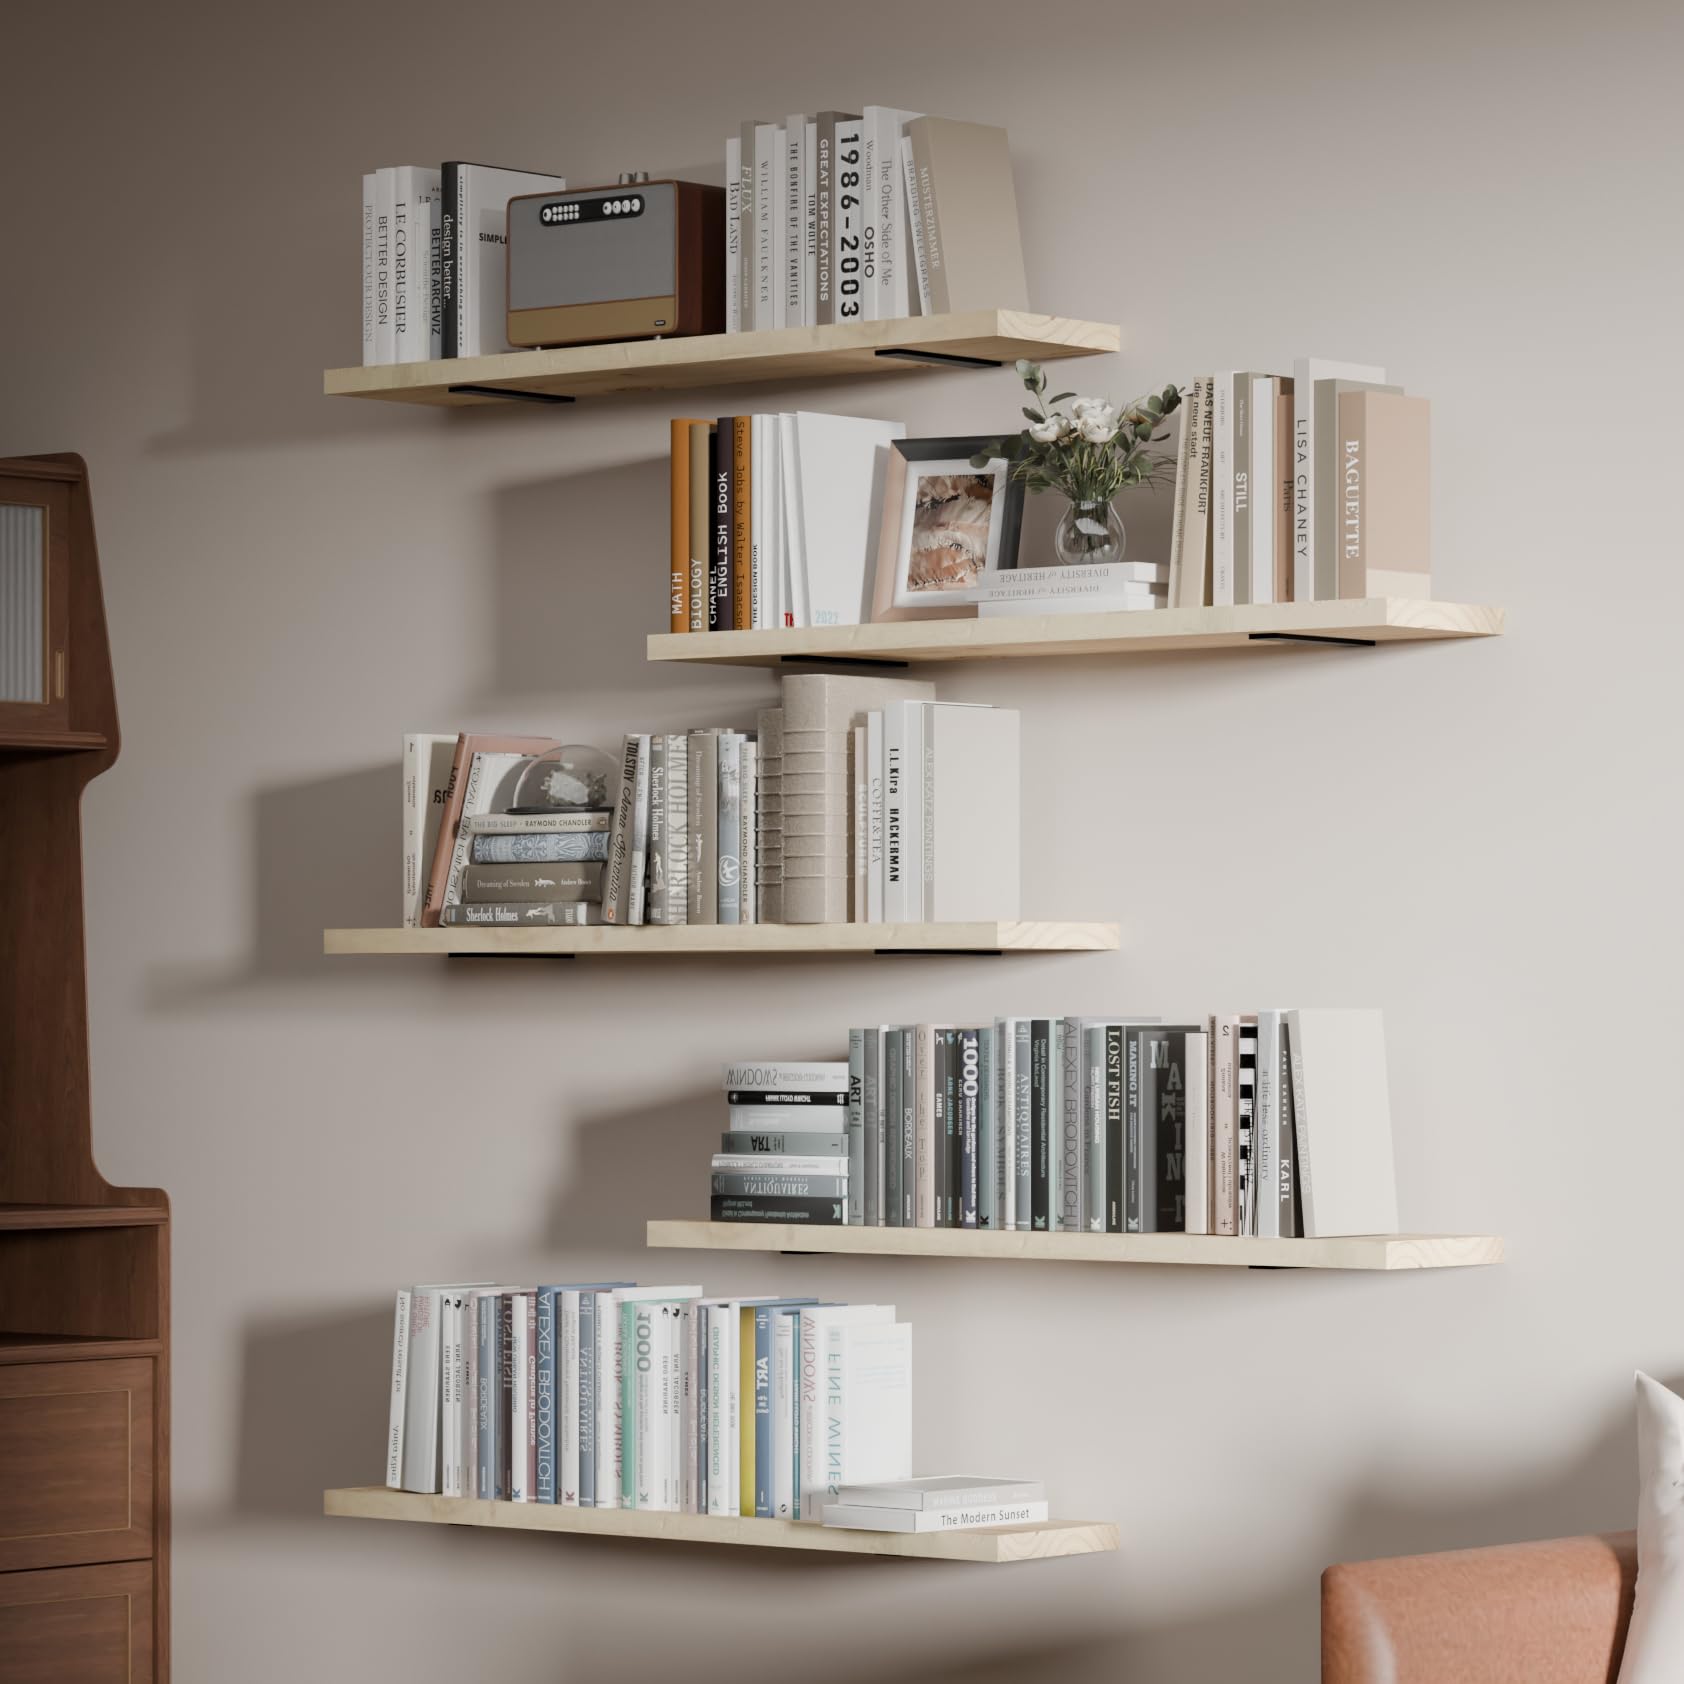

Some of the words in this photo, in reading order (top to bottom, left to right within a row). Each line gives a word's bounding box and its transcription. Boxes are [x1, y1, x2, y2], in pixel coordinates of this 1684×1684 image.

[790, 143, 798, 160] THE
[820, 138, 828, 188] GREAT
[866, 140, 874, 191] Woodman
[880, 159, 892, 180] The
[730, 182, 740, 211] BAD
[742, 165, 752, 214] FLUX
[760, 161, 768, 221] WILLIAM
[790, 167, 798, 210] BONFIRE
[808, 194, 816, 216] TOM
[880, 184, 892, 220] Other
[365, 206, 373, 258] PROTECT
[395, 203, 406, 223] LE
[790, 216, 798, 228] OF
[919, 167, 940, 269] MUSTERZIMMER
[378, 216, 388, 266] BETTER
[432, 228, 441, 278] BETTER
[442, 214, 453, 256] design
[479, 232, 507, 244] SIMPLI
[730, 216, 740, 254] LAND
[790, 235, 798, 252] THE
[808, 222, 816, 256] WOLFE
[820, 192, 828, 301] EXPECTATIONS
[864, 226, 874, 278] OSHO
[880, 224, 892, 248] Side
[365, 262, 373, 292] OUR
[760, 229, 768, 302] FAULKNER
[880, 251, 892, 265] of
[880, 268, 892, 286] Me
[378, 271, 388, 324] DESIGN
[395, 229, 406, 334] CORBUSIER
[442, 260, 453, 309] better...
[790, 258, 798, 306] VANITIES
[364, 296, 373, 342] DESIGN
[432, 280, 441, 336] ARCHVIZ
[1193, 382, 1202, 398] die
[1204, 382, 1214, 407] DAS
[736, 421, 744, 457] Steve
[1190, 431, 1200, 458] stadt
[1202, 410, 1214, 443] NEUE
[1297, 419, 1307, 464] LISA
[718, 472, 728, 514] BOOK
[736, 466, 744, 494] Jobs
[1197, 446, 1210, 515] FRANKFURT
[1236, 472, 1248, 512] STILL
[1284, 480, 1294, 512] Paris
[1344, 440, 1360, 559] BAGUETTE
[735, 501, 744, 516] by
[1297, 474, 1307, 557] CHANEY
[718, 525, 728, 598] ENGLISH
[736, 522, 744, 566] Walter
[672, 572, 682, 614] MATH
[691, 559, 702, 629] BIOLOGY
[999, 572, 1046, 584] HERITAGE
[1060, 568, 1109, 579] DIVERSITY
[736, 575, 744, 630] Isaacson
[624, 742, 638, 782] TOLSTOY
[668, 736, 688, 814] HOLMES
[694, 751, 702, 782] Dreaming
[924, 747, 934, 778] ALEX
[652, 766, 664, 804] Sherlock
[696, 786, 702, 796] of
[924, 780, 934, 812] KATZ
[525, 818, 557, 828] RAYMOND
[559, 818, 592, 828] CHANDLER
[618, 786, 632, 828] Anna
[652, 808, 664, 840] Holmes
[889, 808, 900, 882] HACKERMAN
[924, 815, 934, 882] PAINTINGS
[610, 833, 626, 903] Karenina
[668, 821, 688, 925] SHERLOCK
[466, 908, 494, 922] Sherlock
[495, 908, 518, 922] Holmes
[963, 1038, 978, 1096] 1000
[1064, 1022, 1078, 1093] ALEXEY
[1108, 1030, 1120, 1076] LOST
[850, 1075, 861, 1106] ART
[865, 1074, 877, 1107] ART
[1108, 1080, 1120, 1121] FISH
[1130, 1094, 1137, 1107] IT
[904, 1108, 912, 1159] BORDEAUX
[1020, 1073, 1030, 1176] ANTIQUAIRES
[1064, 1099, 1078, 1218] BRODOVITCH
[1280, 1160, 1290, 1202] KARL
[941, 1514, 958, 1526] The
[960, 1511, 996, 1524] Modern
[998, 1508, 1030, 1521] Sunset
